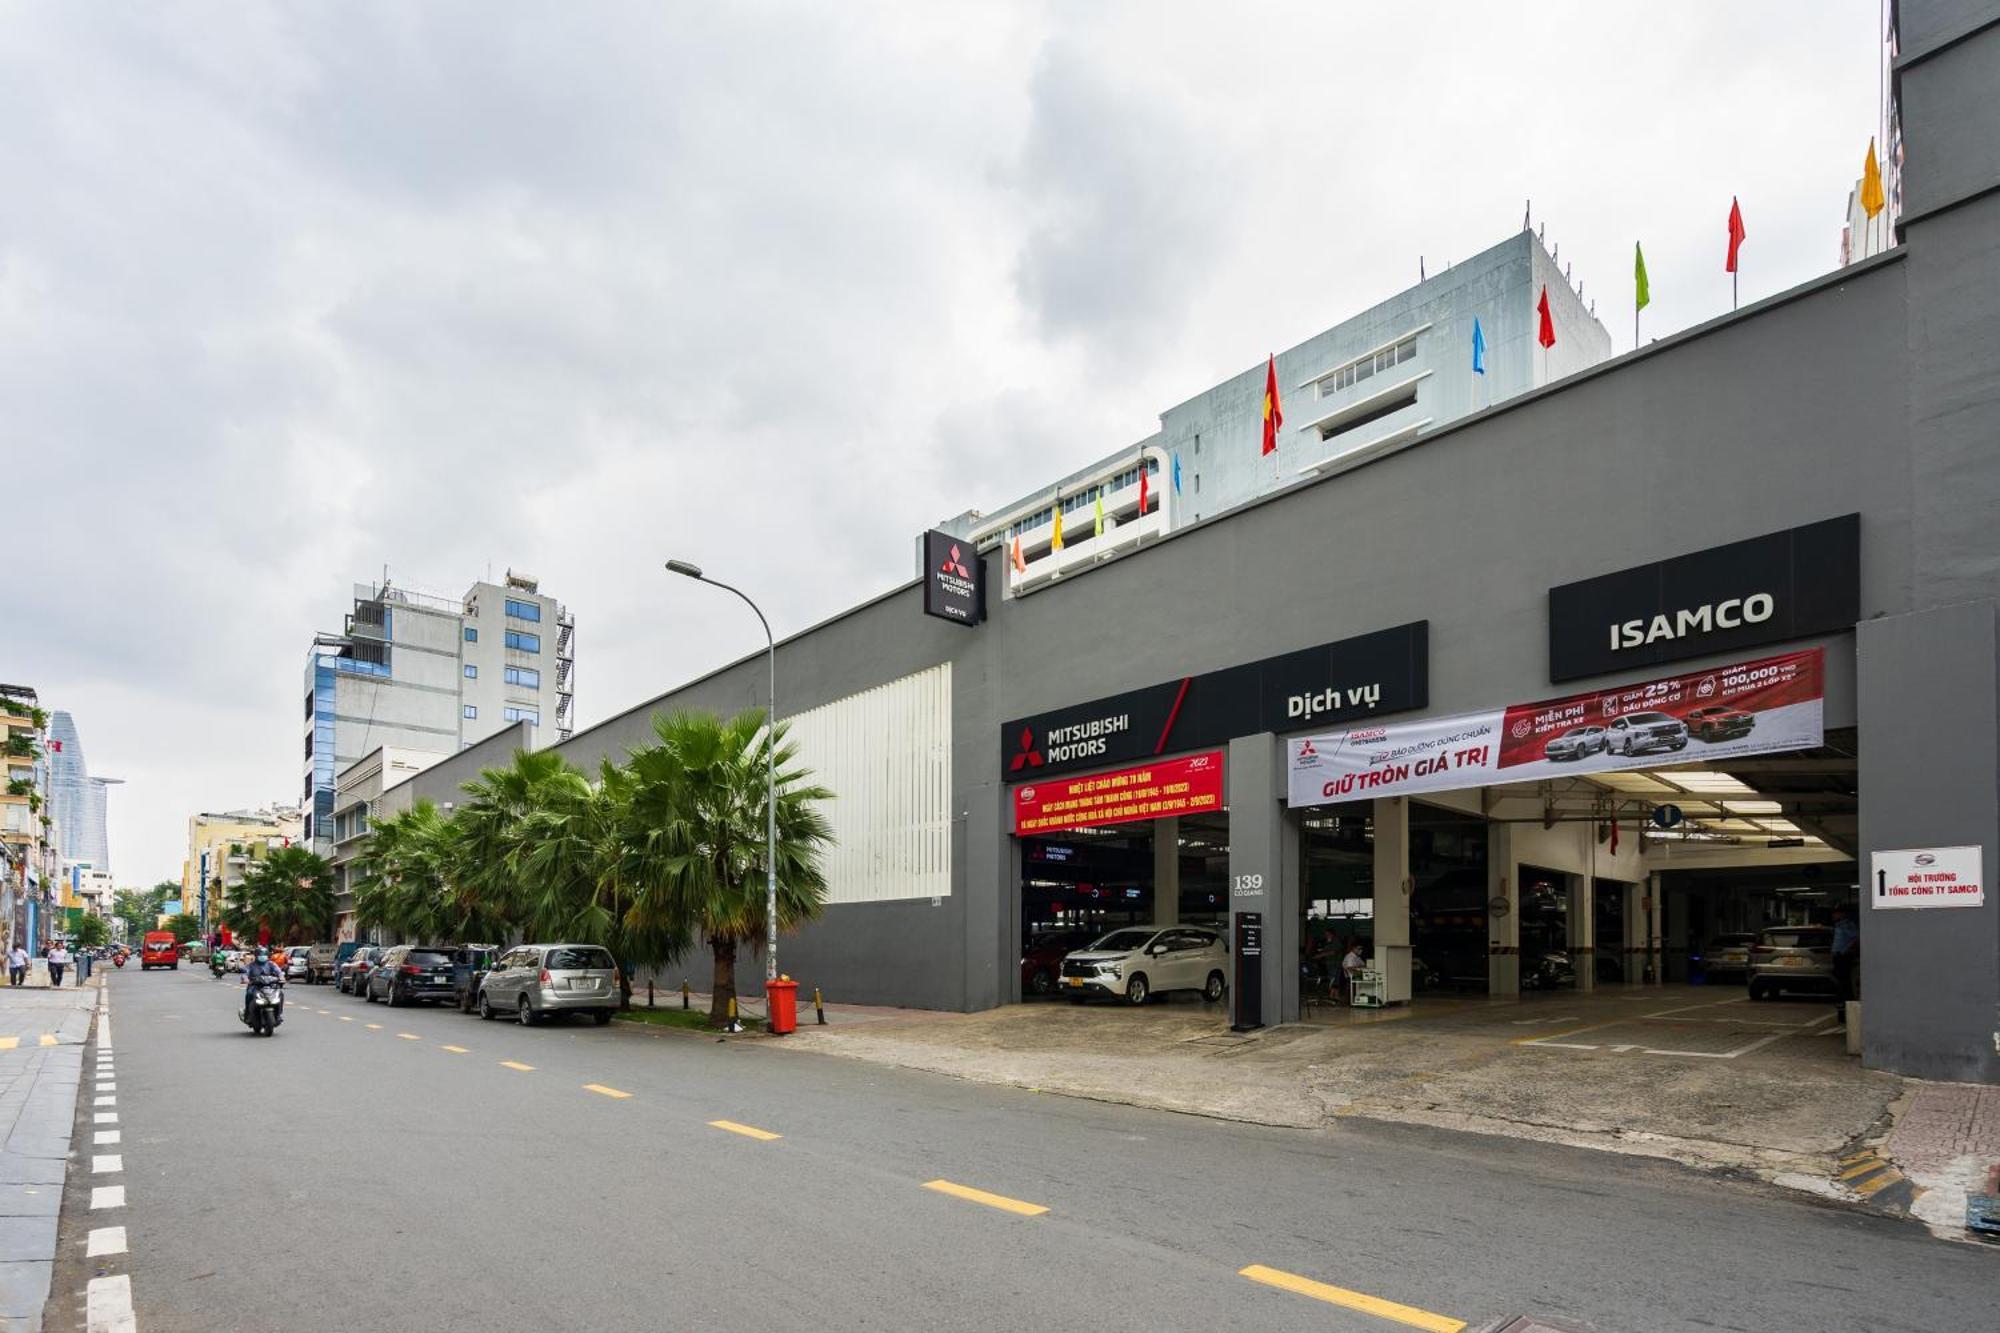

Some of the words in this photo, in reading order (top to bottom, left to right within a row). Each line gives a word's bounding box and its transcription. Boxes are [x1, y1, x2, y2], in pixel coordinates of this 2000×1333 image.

[936, 572, 974, 591] MITSUBISHI
[942, 582, 970, 598] MOTORS
[1609, 592, 1774, 650] ISAMCO
[1722, 666, 1778, 688] 100,000
[1722, 688, 1737, 697] KHI
[1737, 684, 1757, 694] MUA
[1287, 688, 1341, 720] Dịch
[1348, 683, 1380, 708] vụ
[1642, 696, 1668, 710] ĐỘNG
[1535, 709, 1563, 726] MIỄN
[1565, 703, 1585, 720] PHÍ
[1556, 720, 1572, 730] TRA
[1573, 716, 1584, 726] XE
[1048, 714, 1129, 746] MITSUBISHI
[1048, 738, 1107, 764] MOTORS
[1323, 773, 1356, 797] GIỮ
[1358, 764, 1410, 790] TRÒN
[1414, 750, 1448, 777] GIÁ
[1234, 874, 1263, 890] 139
[1912, 886, 1934, 895] CÔNG
[1936, 886, 1945, 894] TY
[1948, 885, 1978, 894] SAMCO
